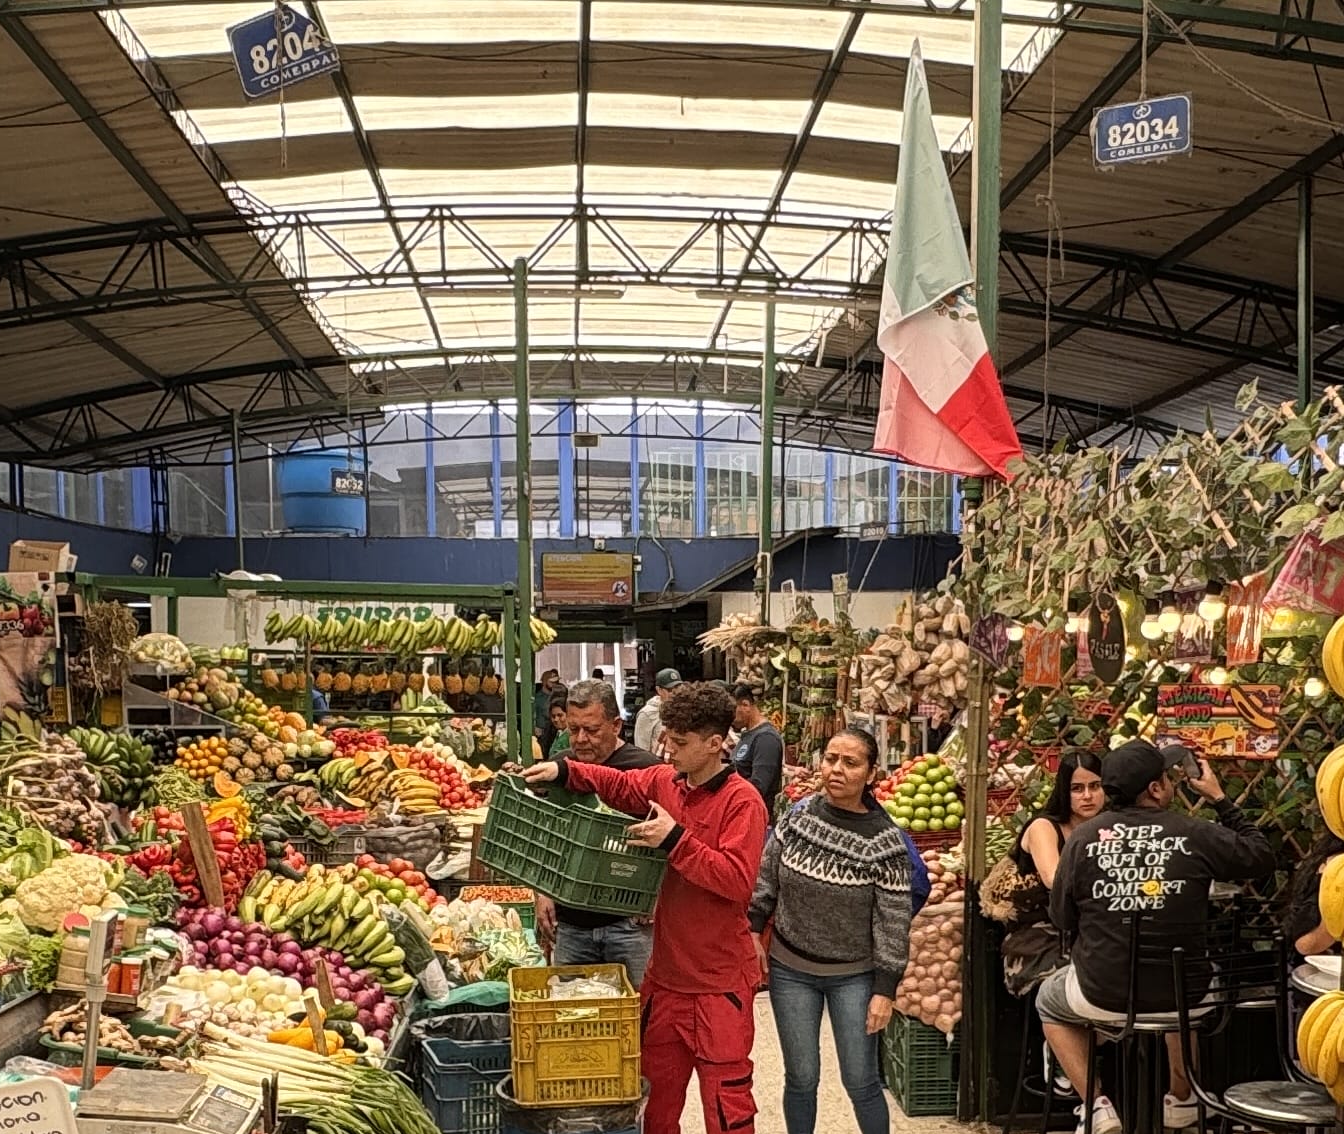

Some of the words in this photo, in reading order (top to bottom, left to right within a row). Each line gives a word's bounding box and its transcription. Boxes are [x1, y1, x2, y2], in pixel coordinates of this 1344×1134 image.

[251, 23, 331, 74] 8204
[260, 52, 339, 88] COMERPAL
[1107, 115, 1180, 148] 82034
[1109, 141, 1176, 158] COMERPAL
[1113, 823, 1163, 840] STEP
[1085, 840, 1123, 858] THE
[1144, 851, 1171, 867] OF
[1108, 867, 1165, 882] YOUR
[1107, 896, 1165, 912] ZONE
